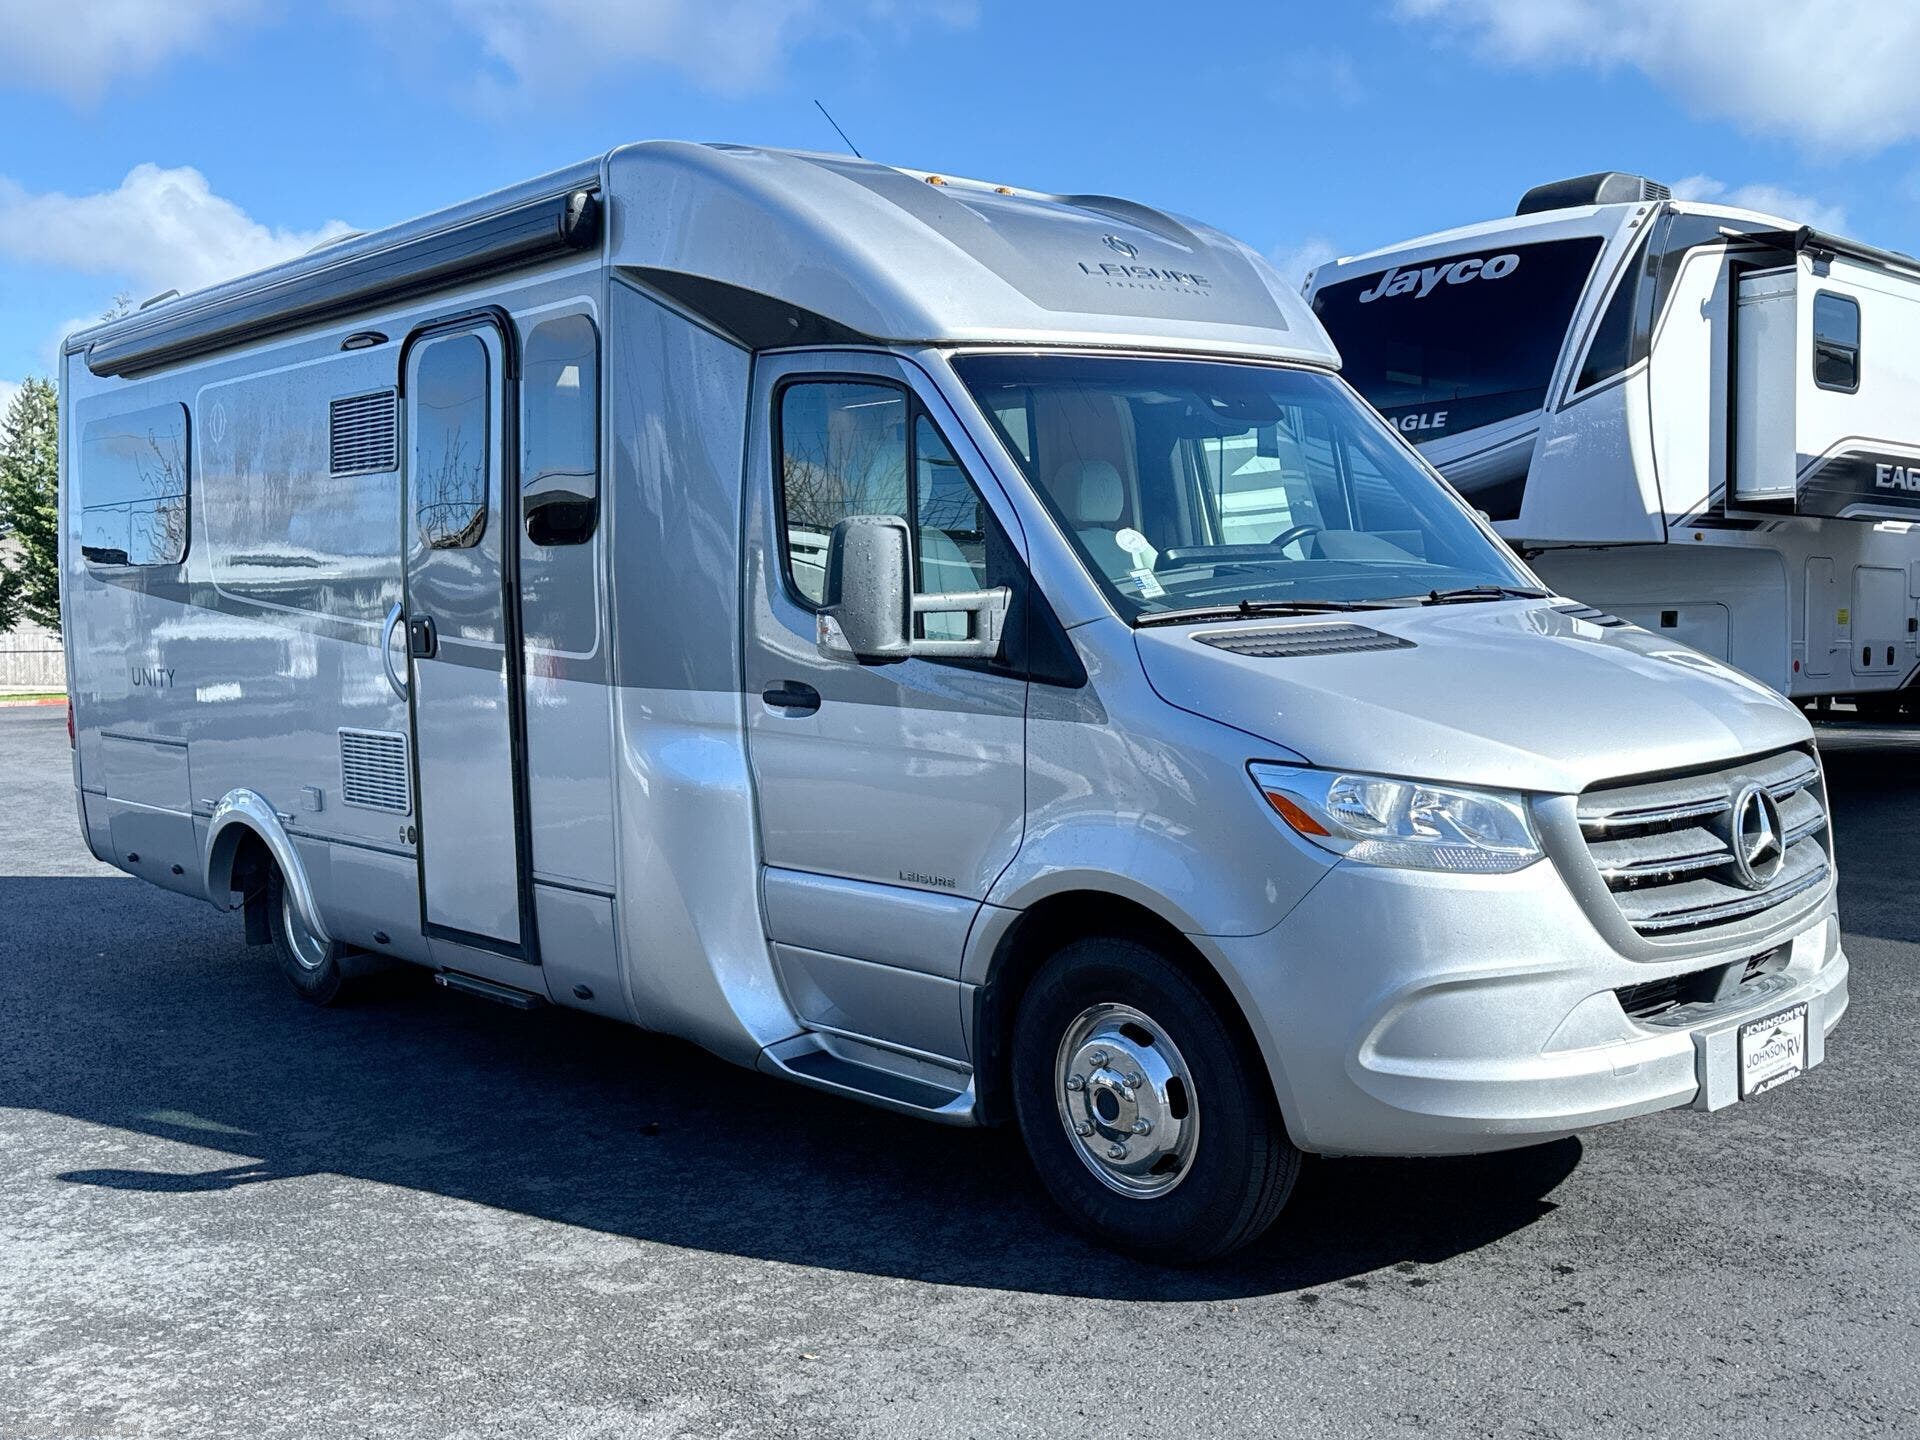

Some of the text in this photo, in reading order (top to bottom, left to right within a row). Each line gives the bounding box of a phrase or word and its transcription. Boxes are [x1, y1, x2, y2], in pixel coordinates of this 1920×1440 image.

[1078, 262, 1212, 288] LEISURE
[1359, 254, 1520, 303] Jayco
[131, 666, 175, 688] UNITY
[899, 870, 956, 888] LEISURE
